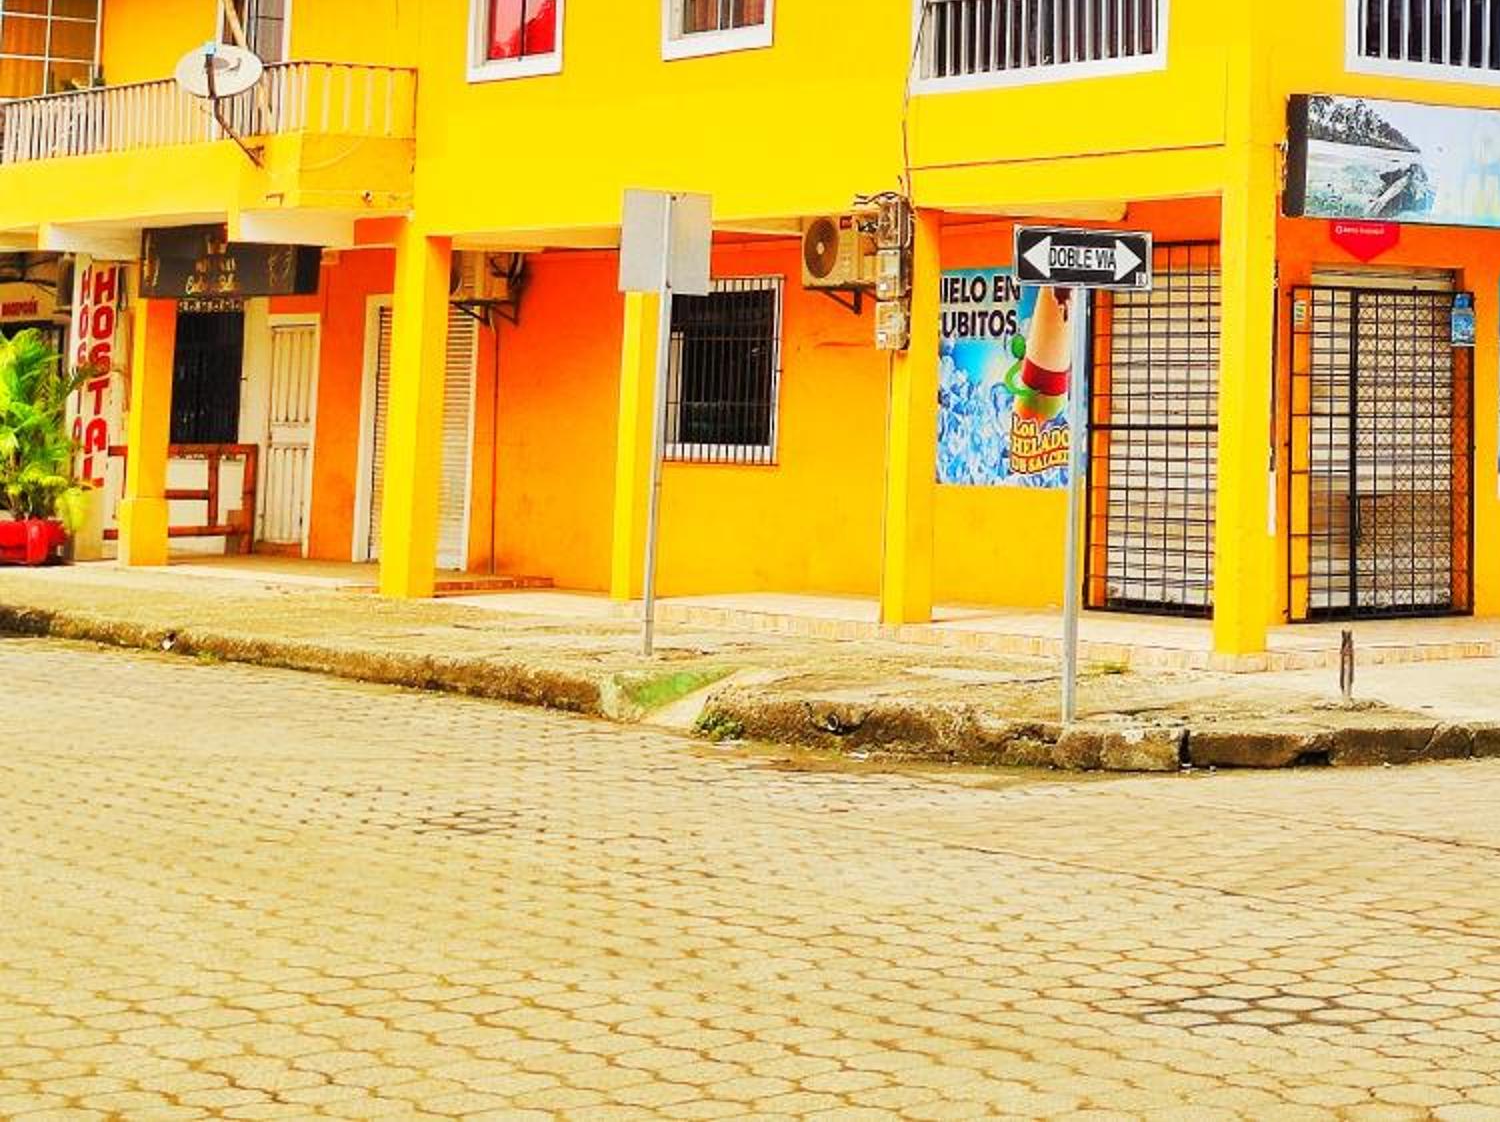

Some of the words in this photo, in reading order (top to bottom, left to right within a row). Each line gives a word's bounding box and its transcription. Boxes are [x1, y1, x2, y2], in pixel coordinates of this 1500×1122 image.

[1050, 247, 1092, 268] DOBLE
[1095, 249, 1117, 269] VIA
[993, 274, 1020, 302] EN
[941, 309, 1018, 338] UBITOS
[83, 264, 117, 488] HOSTAL
[1012, 428, 1070, 455] HELADO
